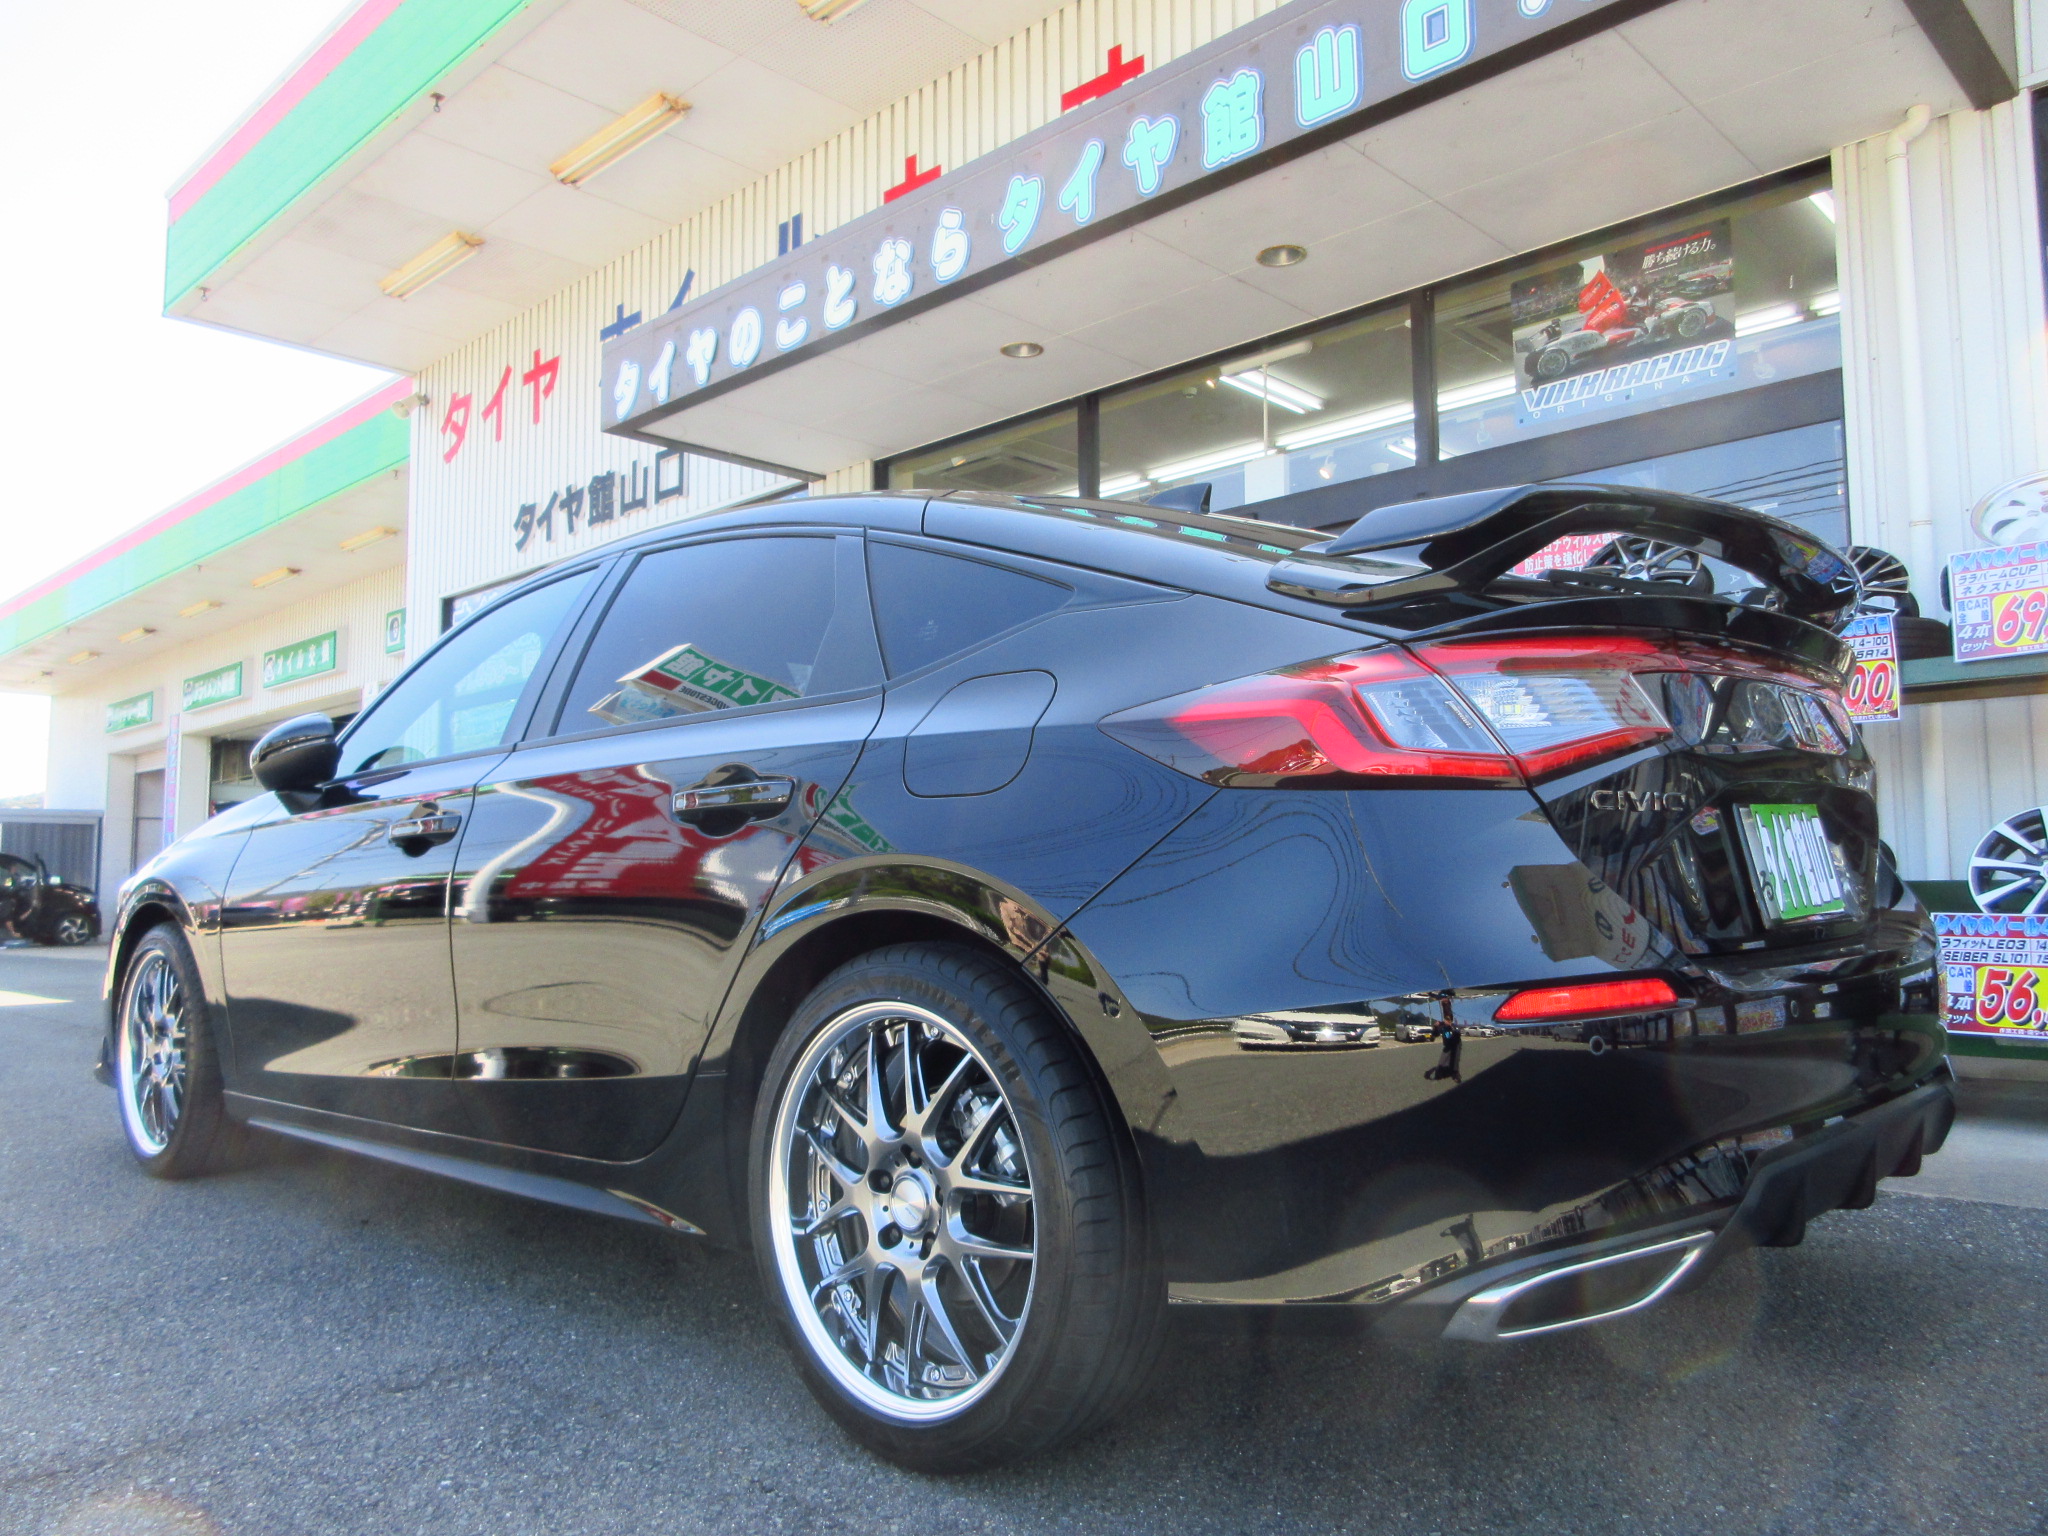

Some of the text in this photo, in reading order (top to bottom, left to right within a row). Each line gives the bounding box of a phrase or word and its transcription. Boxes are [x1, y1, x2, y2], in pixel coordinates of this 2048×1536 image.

[1533, 369, 1717, 419] ORIGINAL
[441, 348, 560, 464] タイヤ
[513, 449, 688, 552] タイヤ館山口
[1958, 623, 1991, 639] 4本
[1960, 640, 1992, 653] セット
[1590, 789, 1686, 812] CIVIC
[1944, 951, 1989, 962] SEIBER
